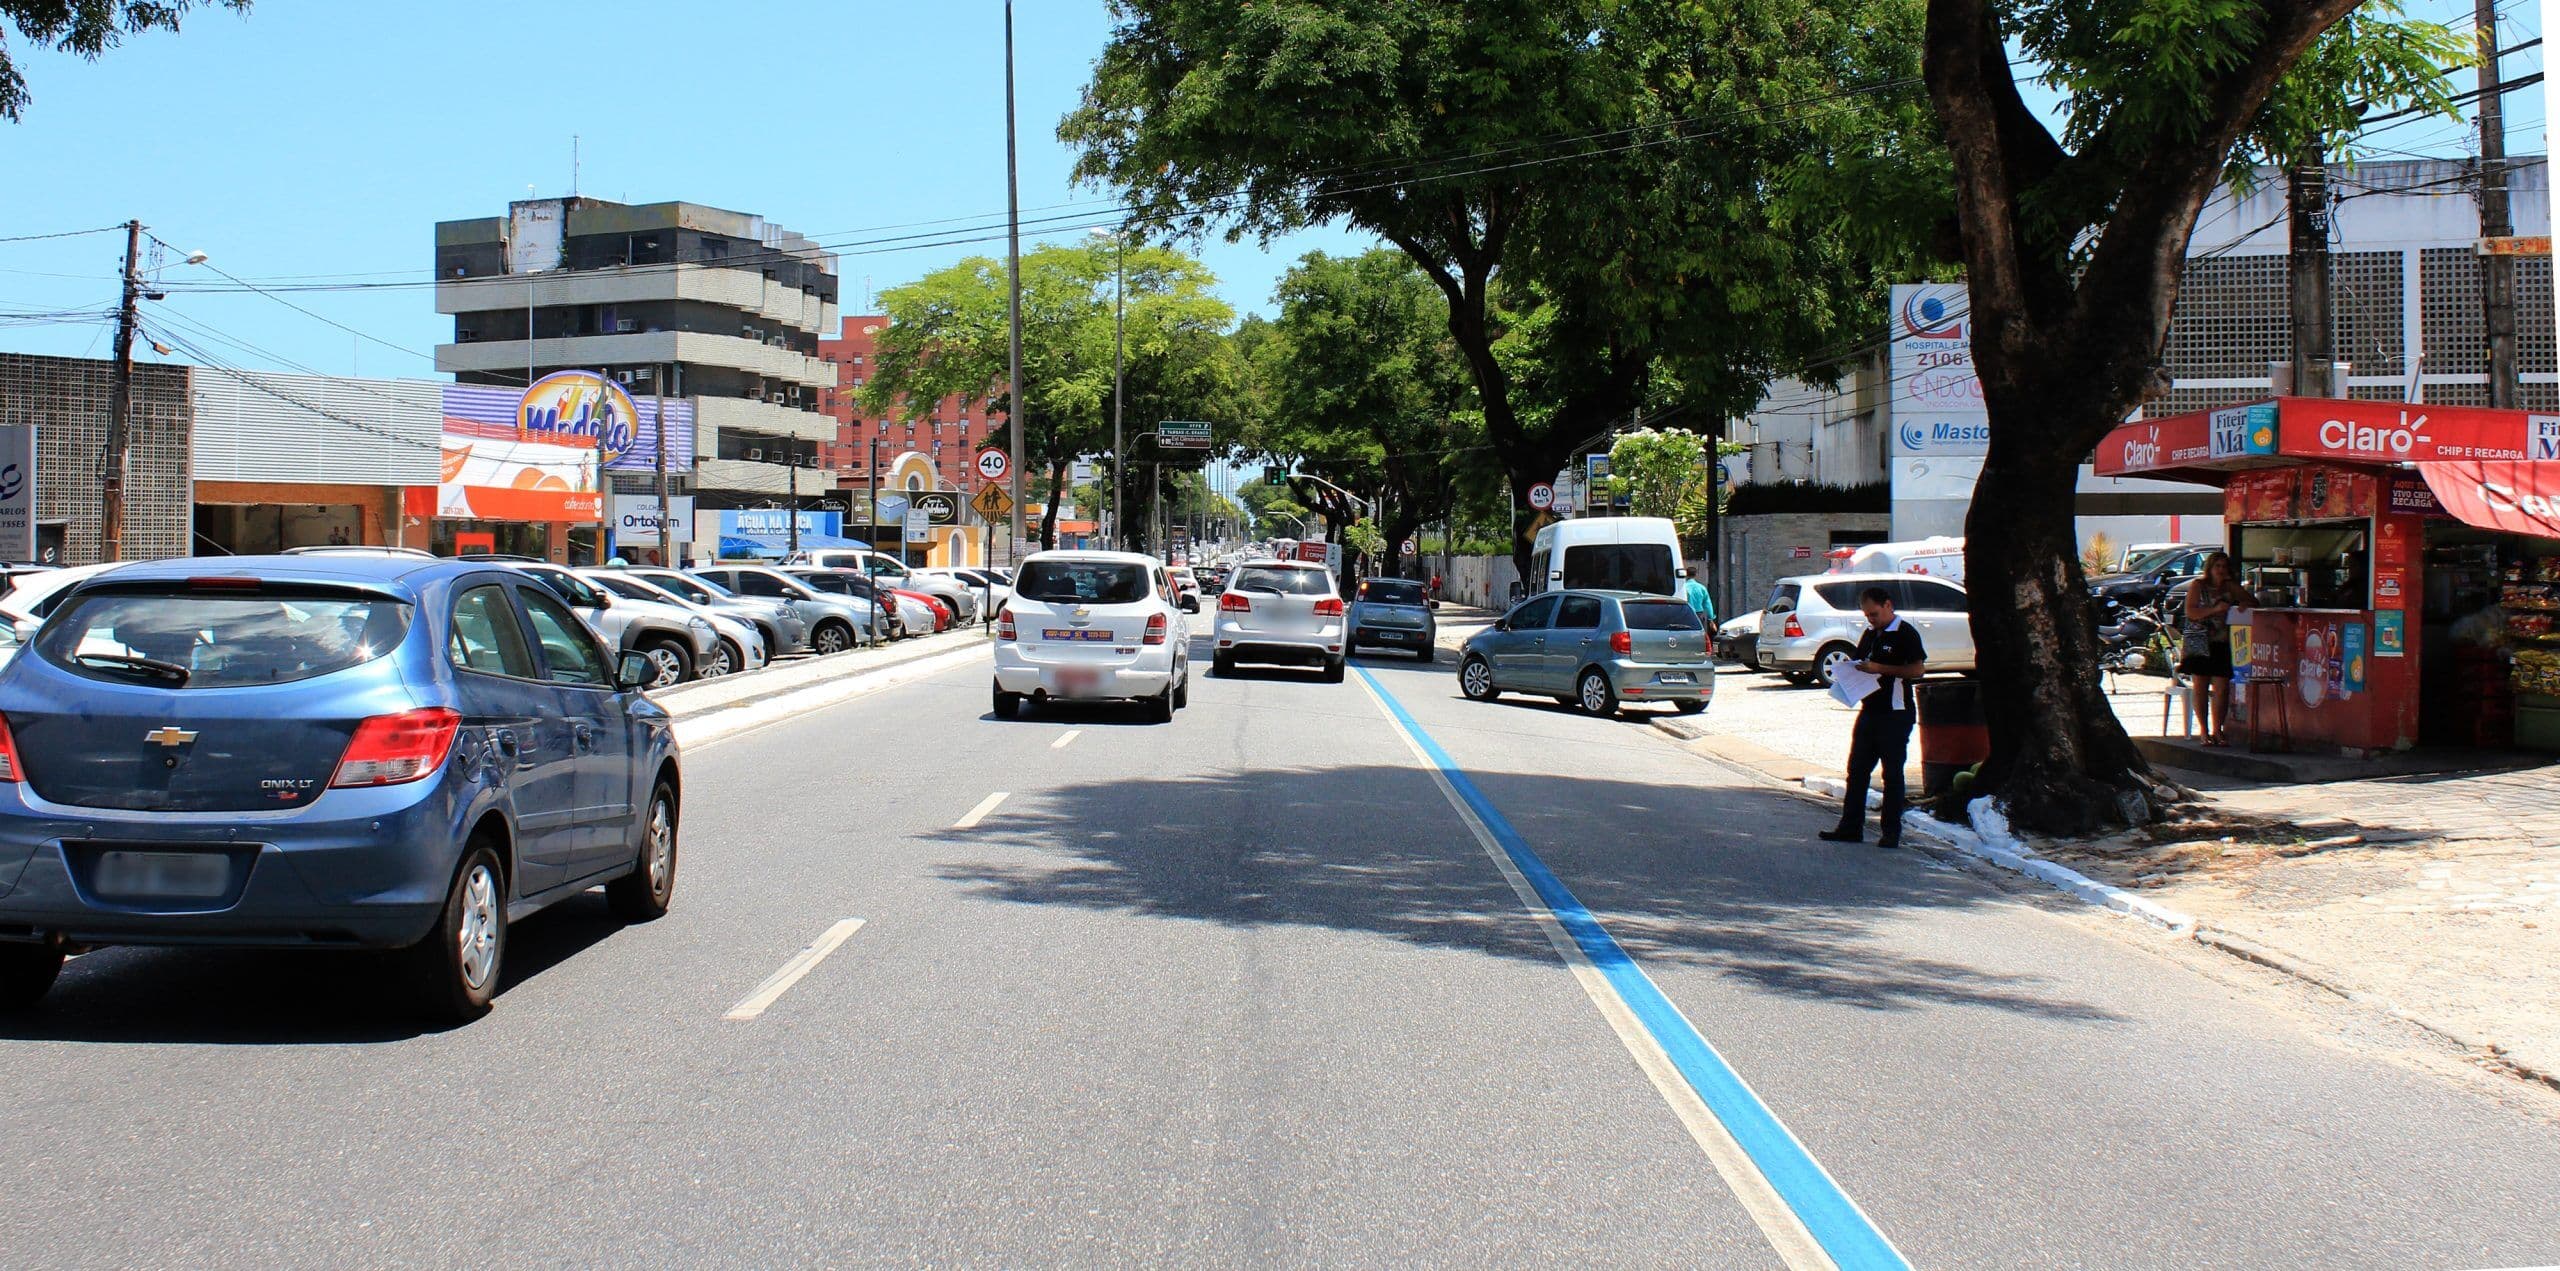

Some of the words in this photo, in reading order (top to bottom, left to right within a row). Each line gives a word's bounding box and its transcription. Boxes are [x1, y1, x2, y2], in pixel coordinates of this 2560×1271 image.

[1905, 341, 1949, 350] HOSPITAL
[1918, 353, 1969, 366] 2106-
[2216, 411, 2247, 429] Fiteir
[2538, 422, 2560, 436] Fi
[2215, 426, 2247, 455] Má
[2320, 419, 2413, 453] Claro
[2124, 438, 2156, 466] Claro
[2437, 446, 2463, 456] CHIP
[2465, 447, 2472, 457] E
[2474, 448, 2524, 460] RECARGA
[980, 456, 1004, 469] 40
[1534, 488, 1549, 497] 40
[2392, 490, 2411, 498] VIVO
[2413, 491, 2431, 499] CHIP
[2392, 498, 2432, 508] RECARGA
[0, 507, 26, 516] ARLOS
[0, 520, 26, 528] YSSES
[623, 514, 680, 528] Ortobm
[737, 511, 763, 529] ÁGUA
[769, 513, 783, 529] NA
[2252, 643, 2271, 662] CHIP
[2273, 645, 2280, 662] E
[260, 779, 296, 789] ONIX
[299, 779, 314, 788] LT
